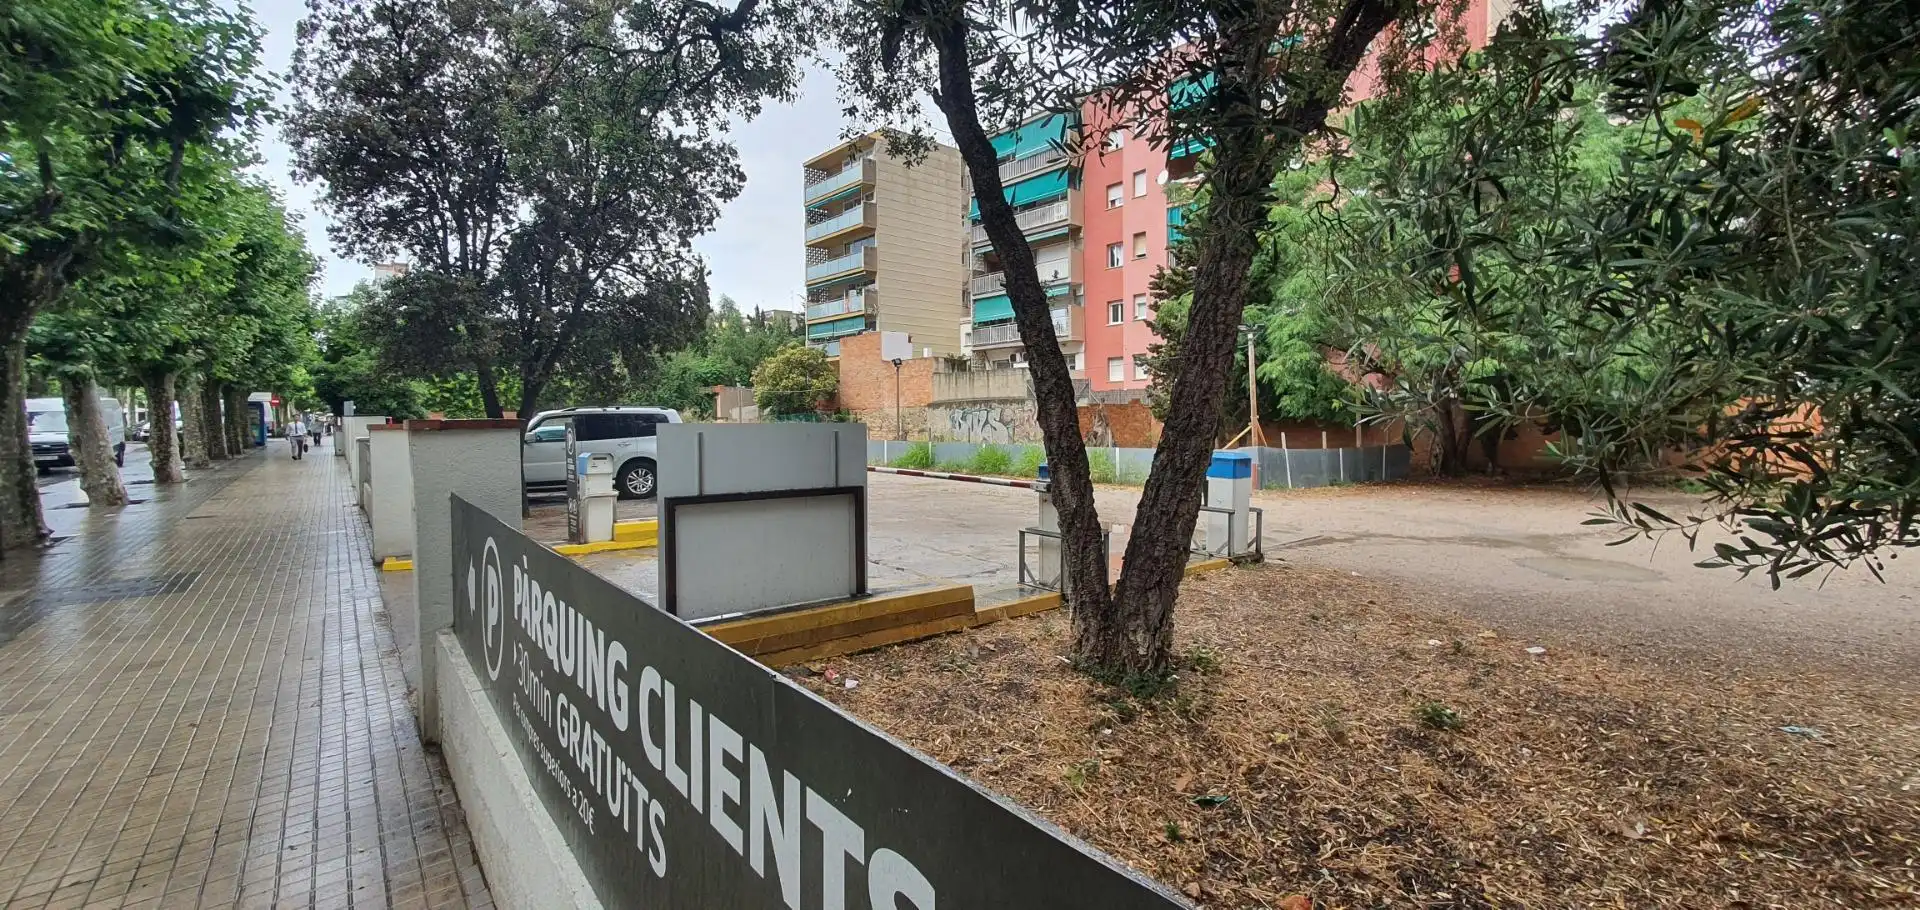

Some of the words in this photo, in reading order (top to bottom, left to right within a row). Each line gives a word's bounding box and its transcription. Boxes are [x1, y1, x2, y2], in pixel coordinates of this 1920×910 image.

[487, 564, 499, 648] P
[513, 554, 629, 732] PÀRQUING
[512, 691, 520, 717] Per
[520, 710, 541, 753] compres
[540, 742, 571, 798] superiors
[572, 787, 577, 809] a
[578, 790, 595, 836] 20€
[518, 642, 552, 728] 30min
[556, 692, 667, 879] GRATUÏTS
